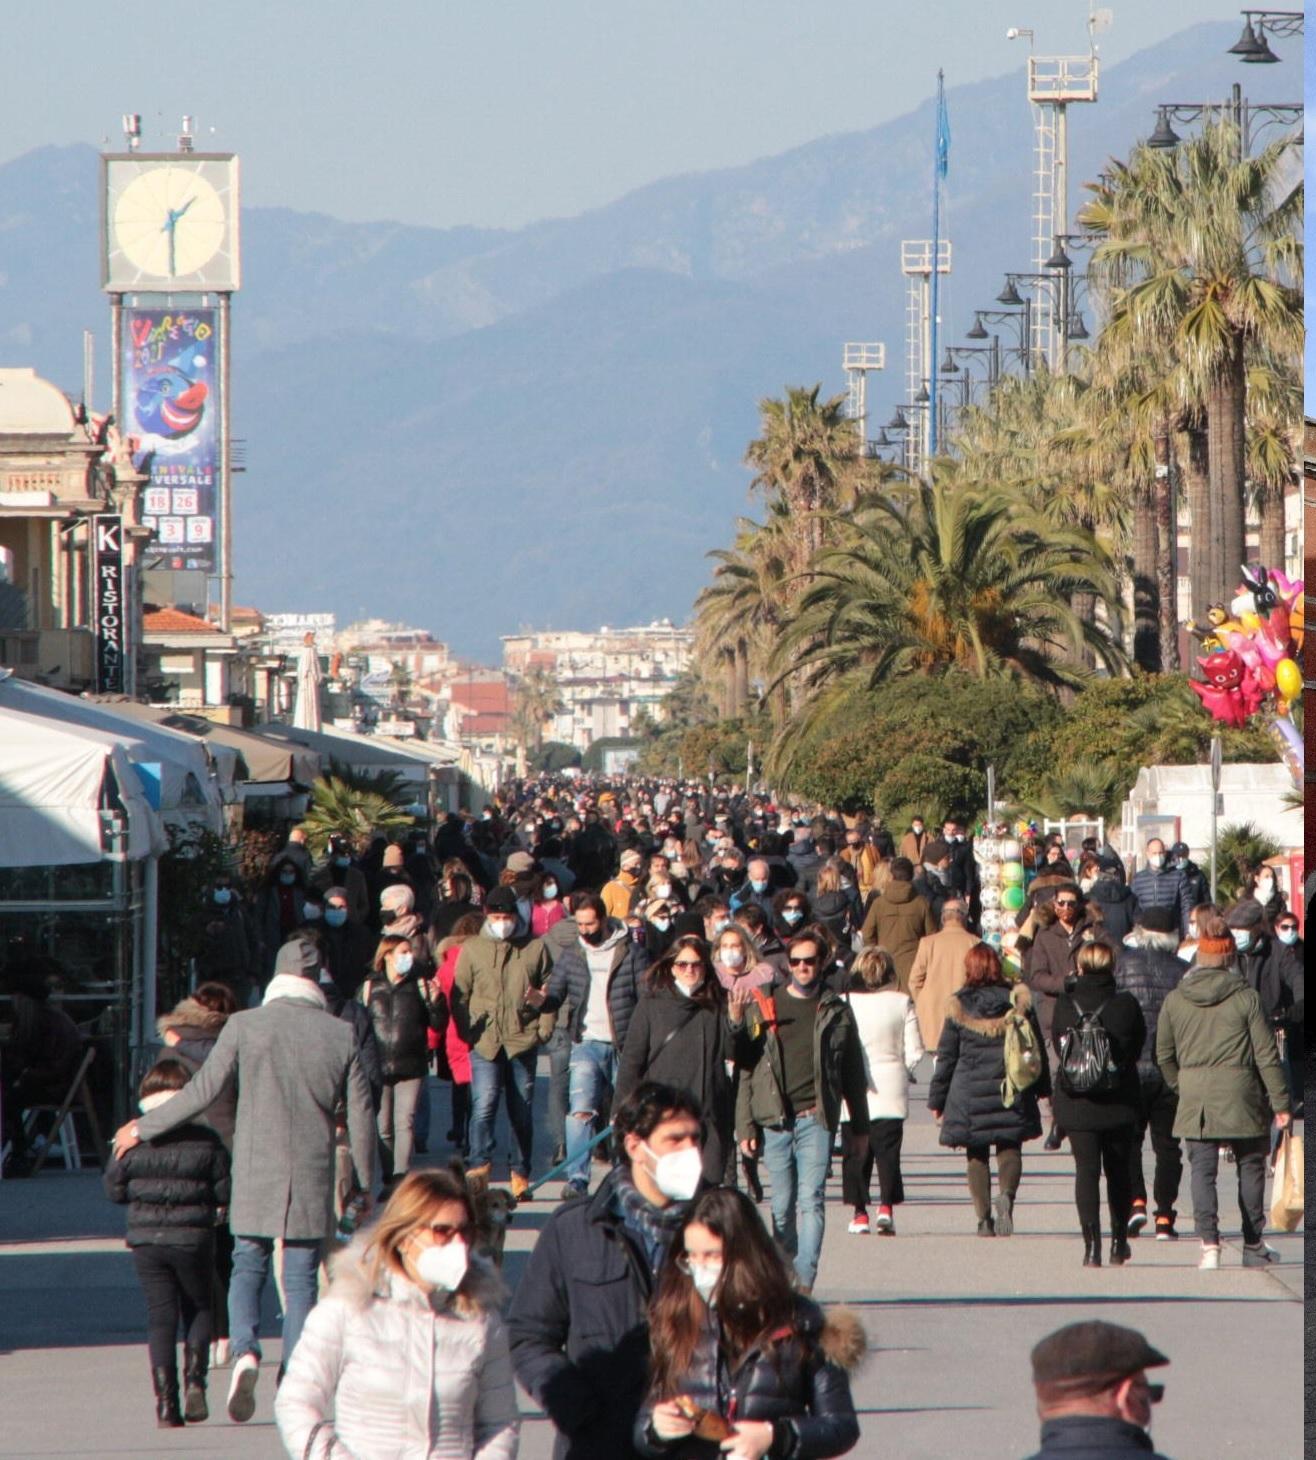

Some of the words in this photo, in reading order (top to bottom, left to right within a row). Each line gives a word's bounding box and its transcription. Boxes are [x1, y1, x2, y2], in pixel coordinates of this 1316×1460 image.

[150, 475, 213, 485] VERSALE
[150, 495, 165, 508] 18
[177, 495, 193, 508] 26
[99, 525, 120, 551] K
[167, 524, 175, 537] 3
[195, 524, 203, 538] 9
[101, 565, 120, 690] RISTORANTE
